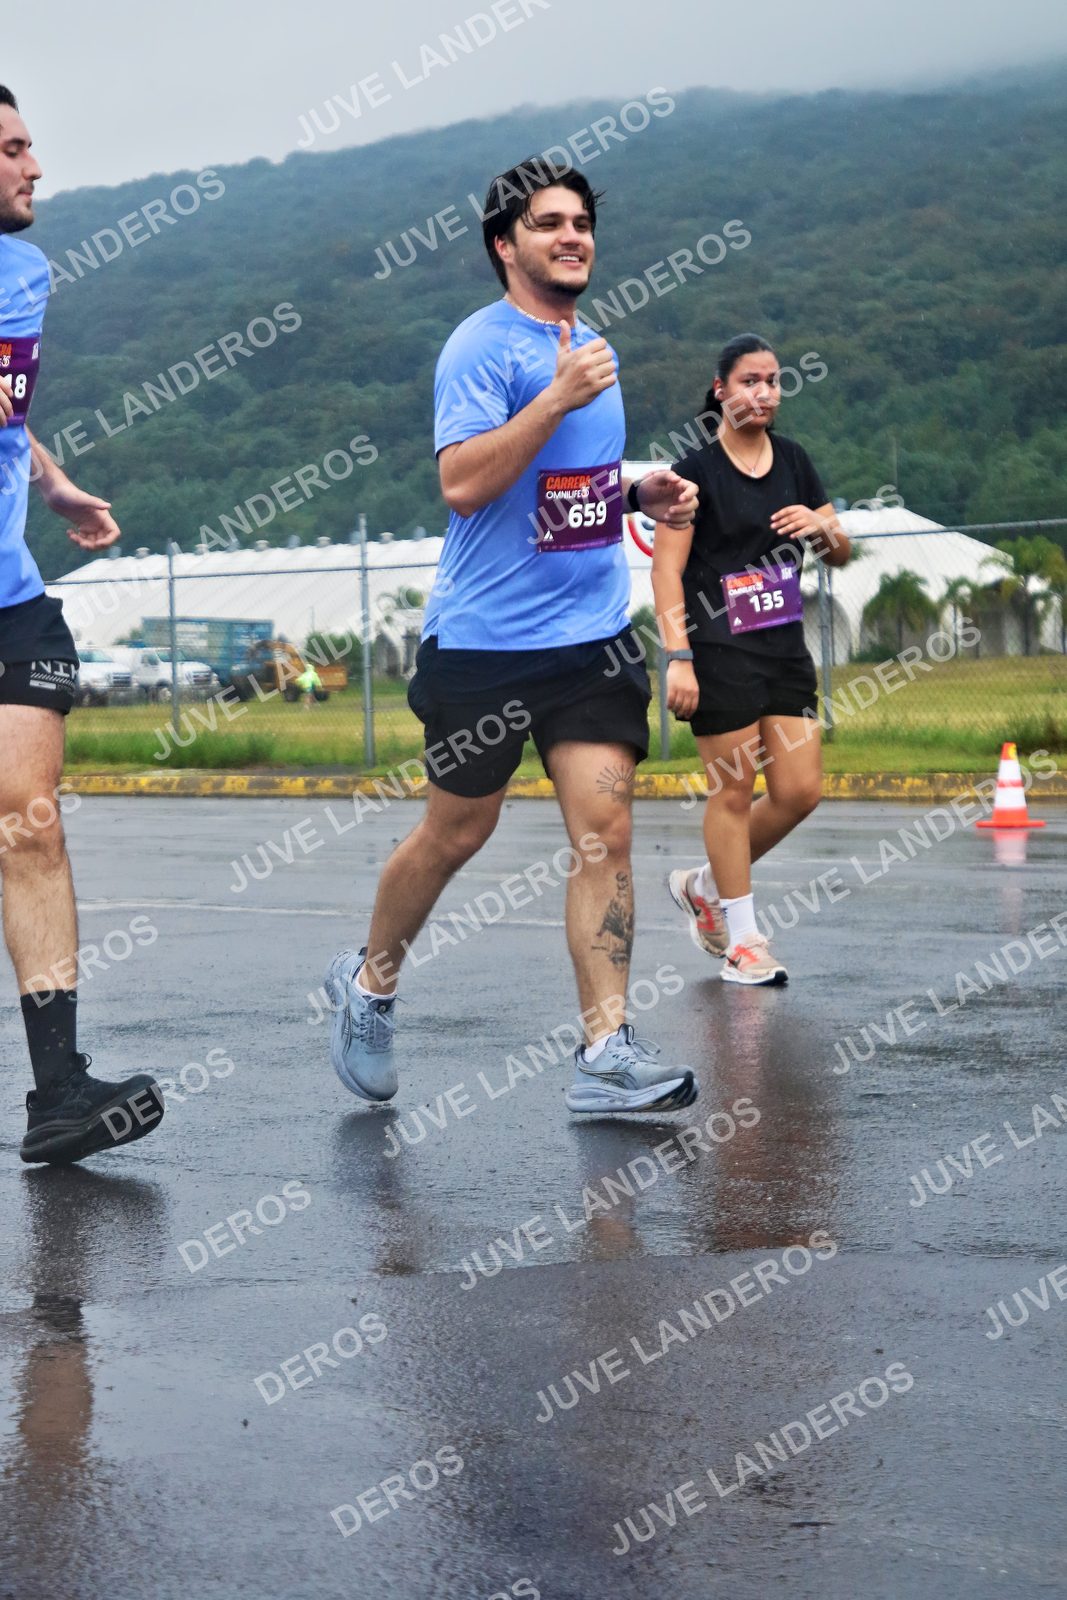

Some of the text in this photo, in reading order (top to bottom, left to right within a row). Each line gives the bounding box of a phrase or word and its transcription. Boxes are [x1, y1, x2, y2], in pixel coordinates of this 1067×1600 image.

[546, 475, 591, 491] CARRERA
[568, 501, 607, 528] 659
[749, 590, 785, 613] 135
